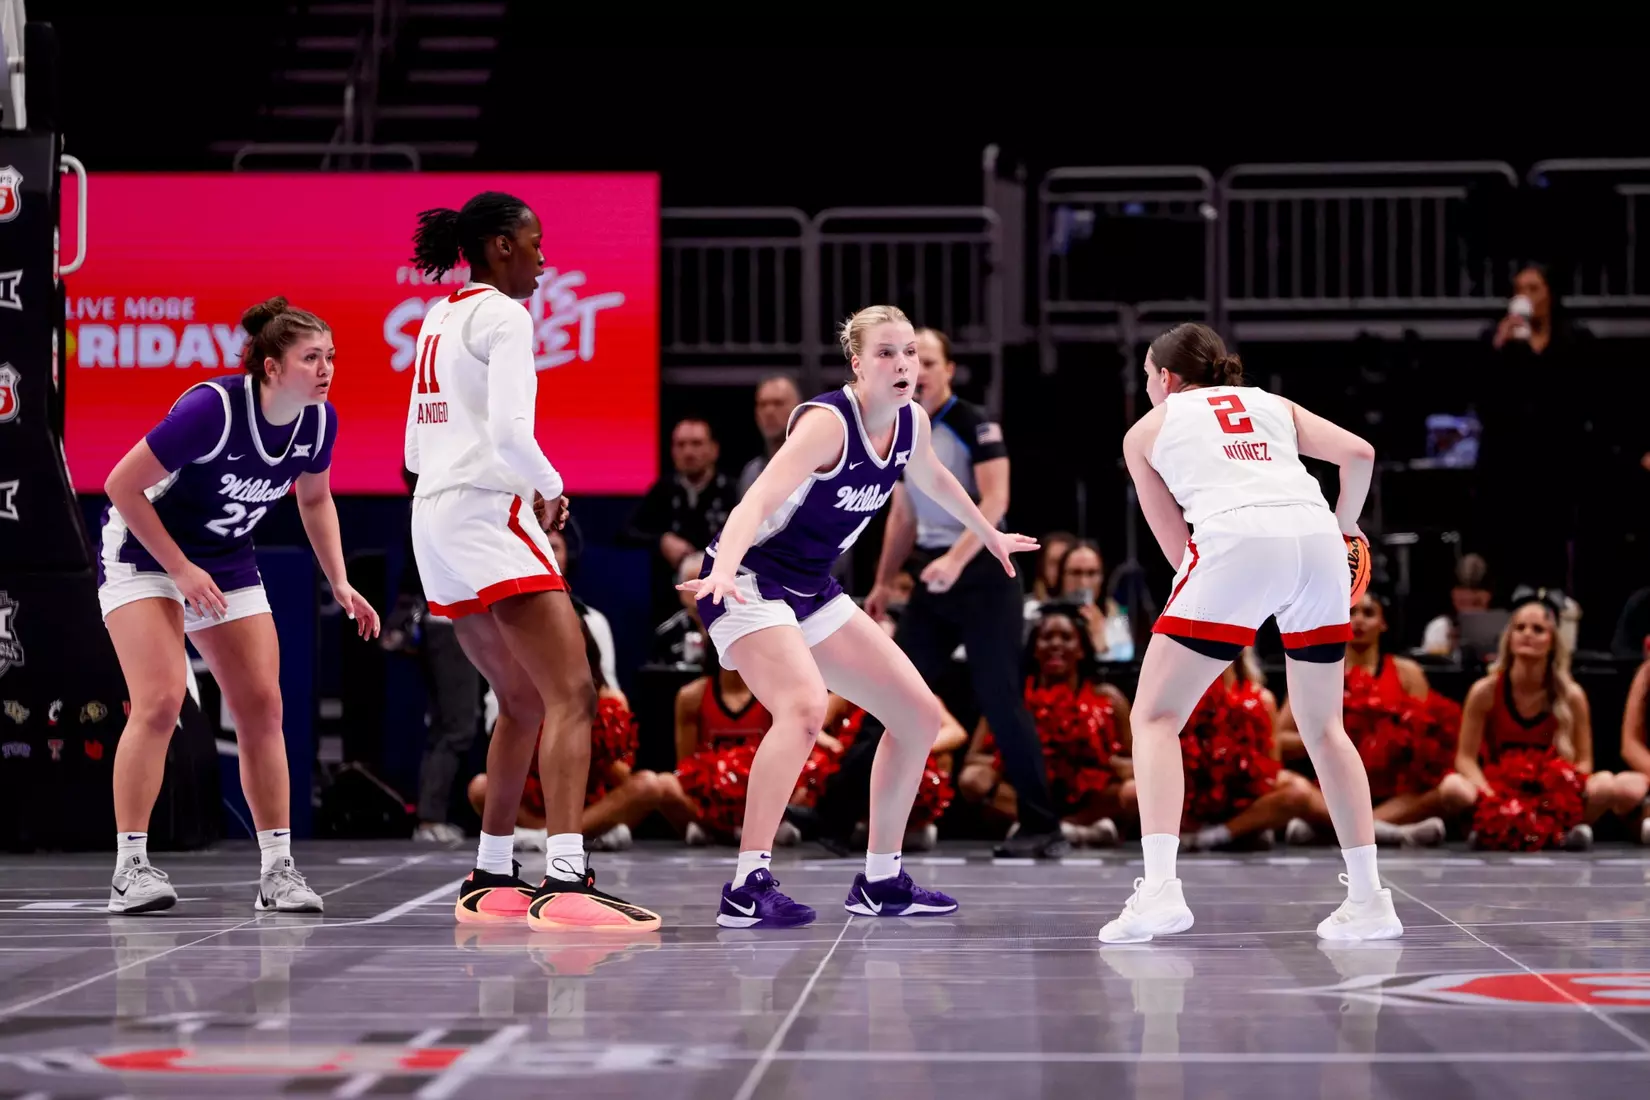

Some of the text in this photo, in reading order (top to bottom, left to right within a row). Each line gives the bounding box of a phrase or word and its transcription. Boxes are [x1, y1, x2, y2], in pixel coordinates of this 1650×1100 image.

[65, 296, 195, 320] LIVE MORE
[417, 333, 441, 394] 11
[416, 401, 449, 424] ANOGO
[1206, 394, 1255, 434] 2
[1222, 440, 1272, 461] NÚÑEZ
